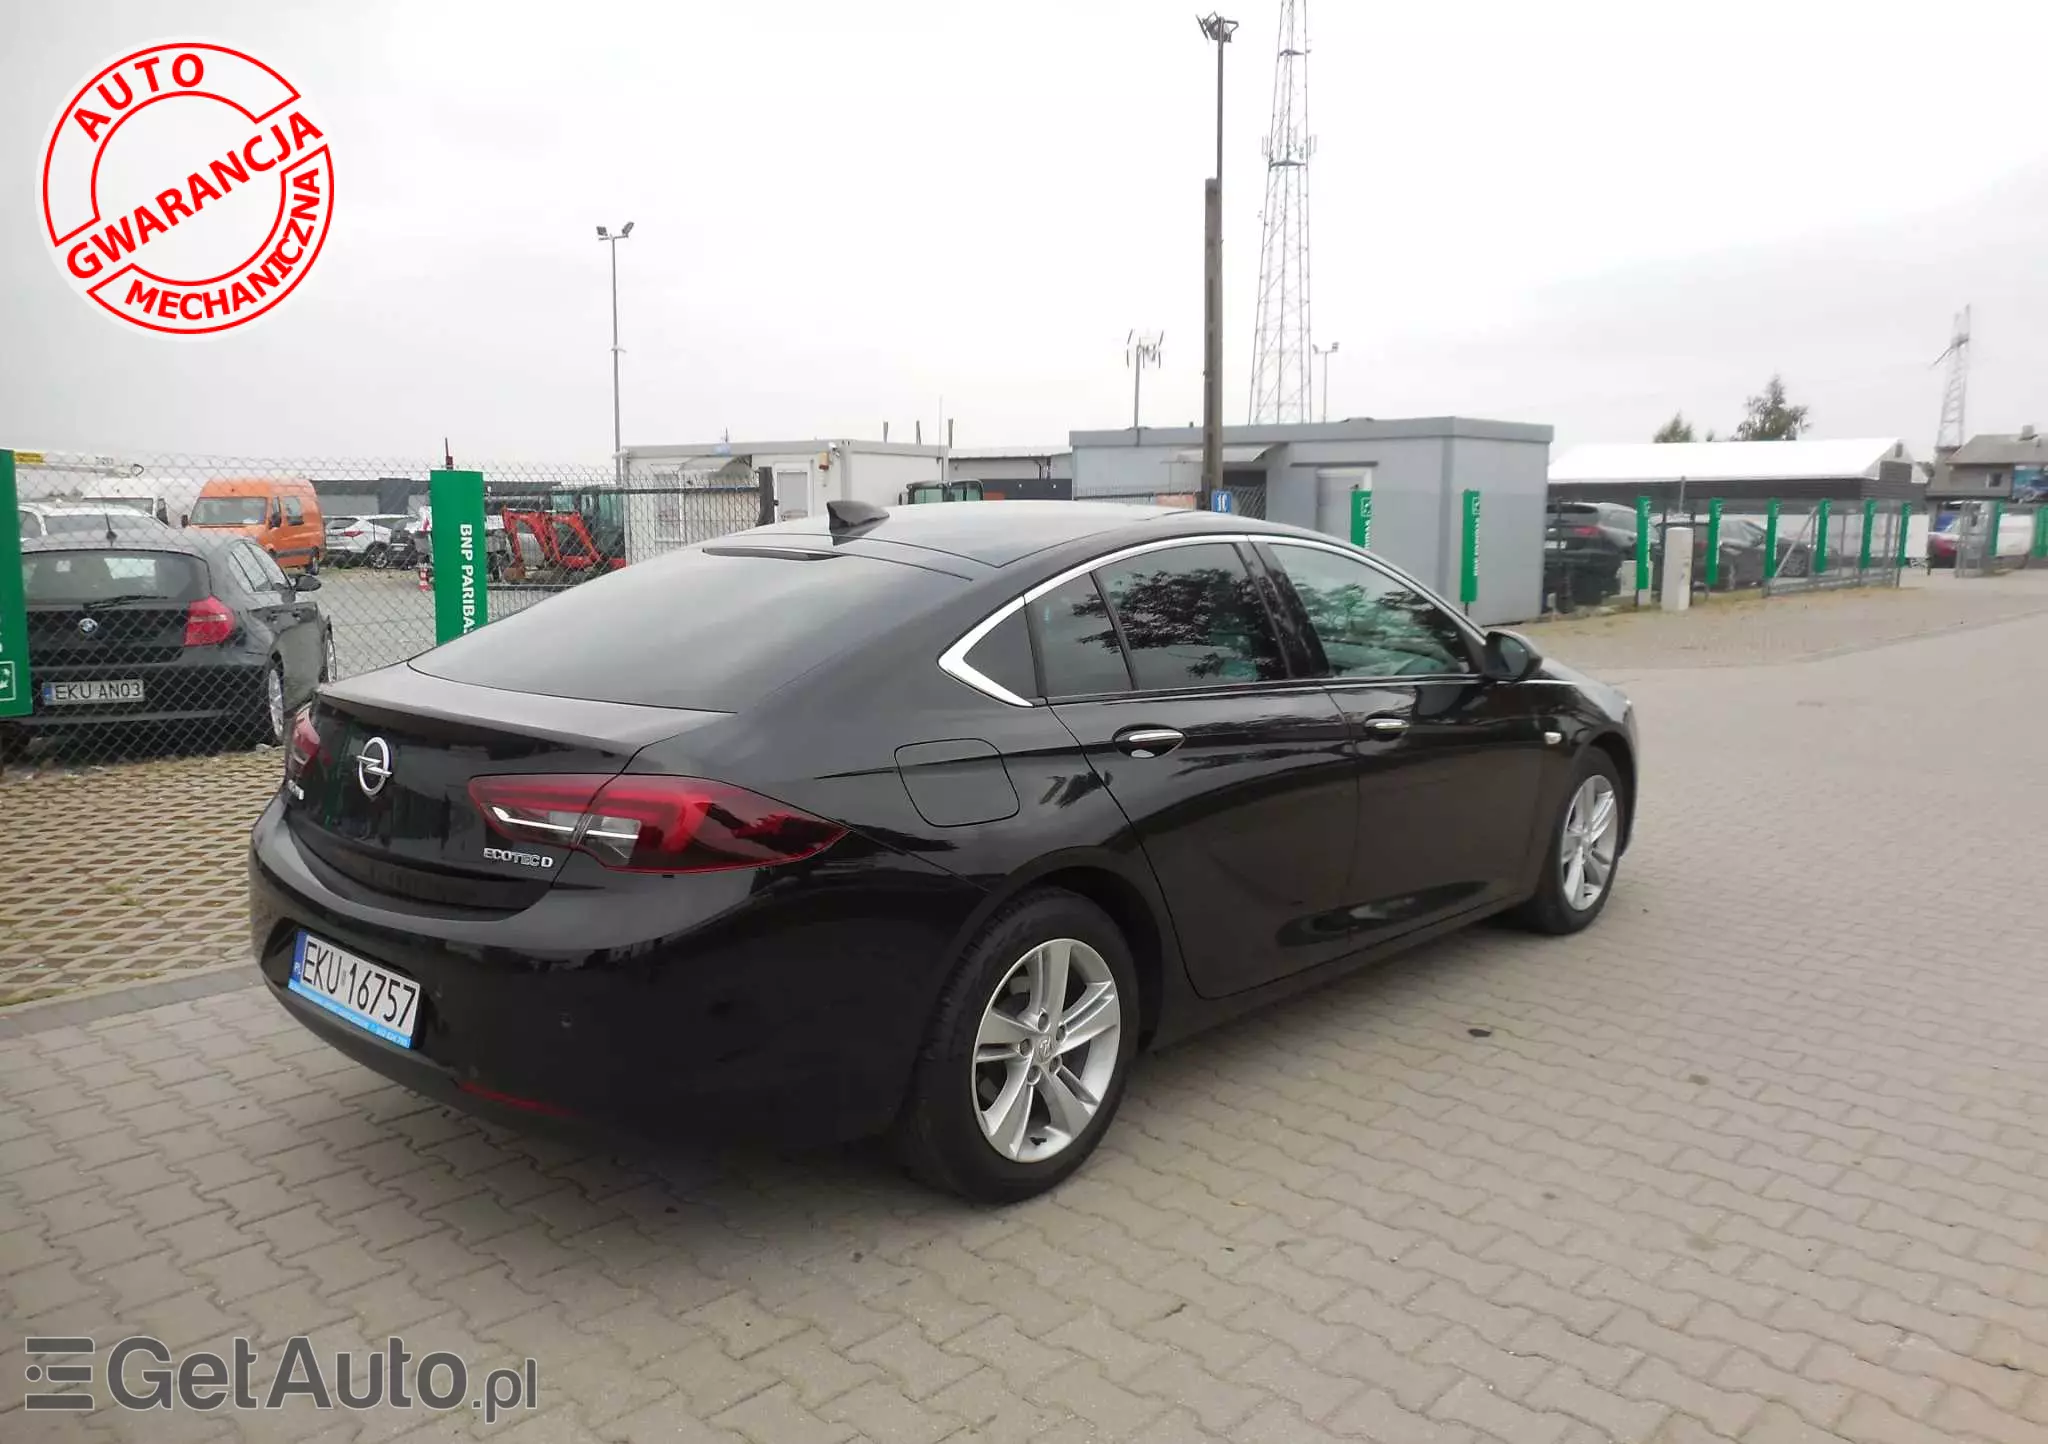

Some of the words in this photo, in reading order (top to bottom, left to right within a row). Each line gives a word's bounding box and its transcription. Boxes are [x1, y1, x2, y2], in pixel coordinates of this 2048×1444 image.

[460, 524, 473, 561] BNP
[461, 565, 475, 634] PARIBA
[56, 684, 91, 699] EKU
[303, 941, 342, 994] EKU
[349, 963, 416, 1027] 16757
